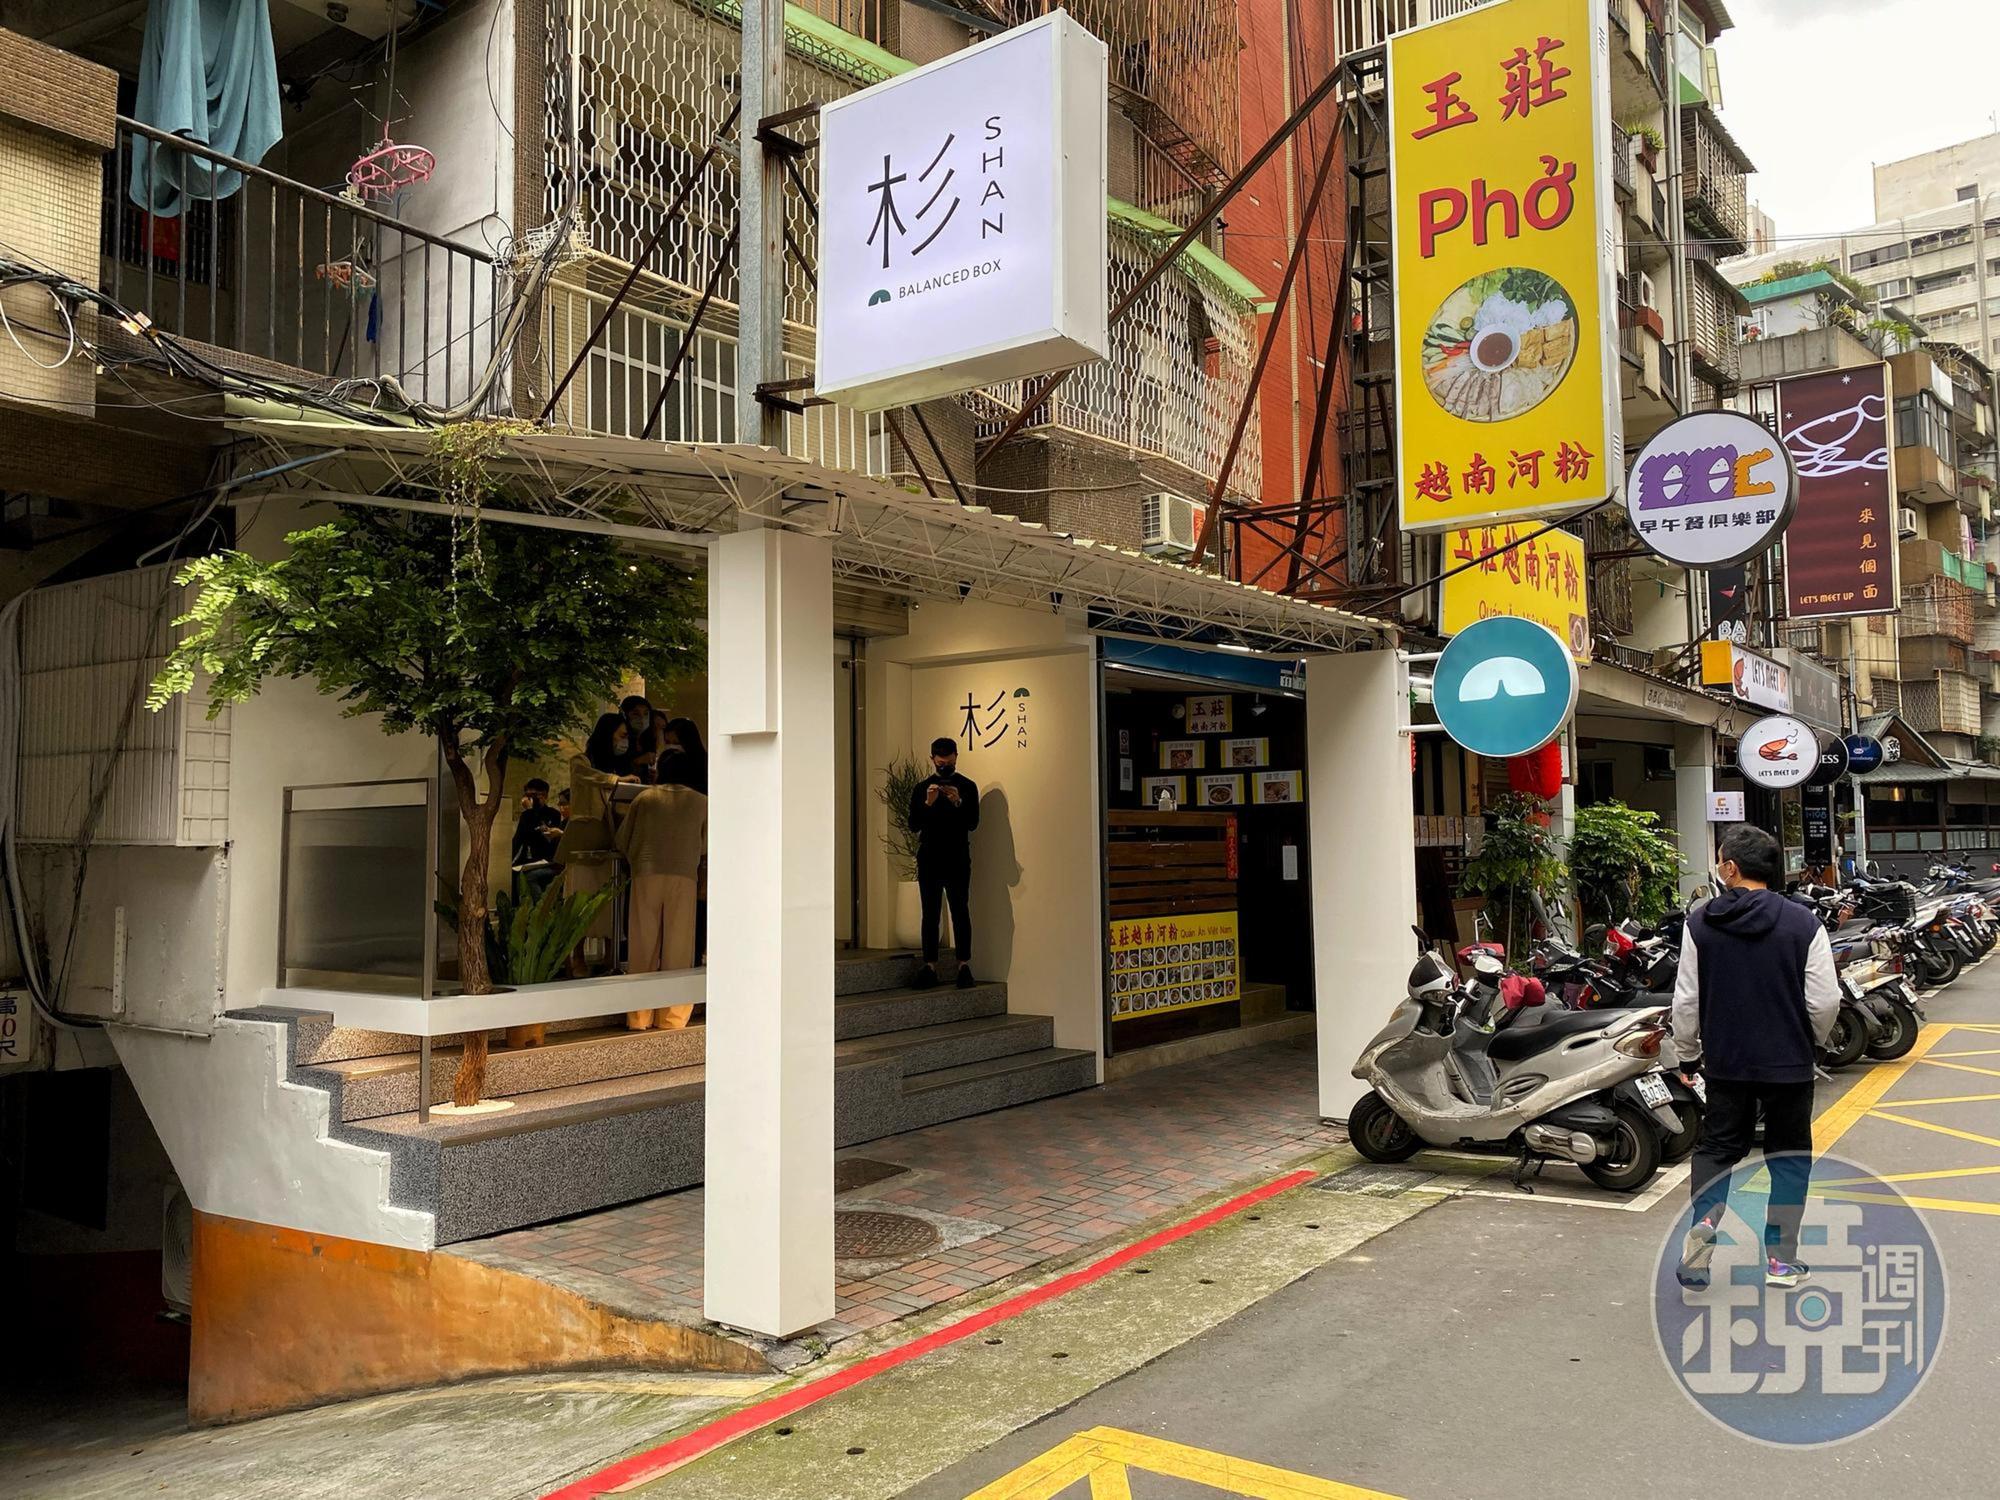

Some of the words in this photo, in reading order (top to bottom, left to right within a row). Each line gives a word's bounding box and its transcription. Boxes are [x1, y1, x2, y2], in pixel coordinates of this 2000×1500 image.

[1411, 36, 1572, 140] 玉莊
[866, 133, 961, 269] 杉
[981, 115, 1005, 240] SHAN
[1419, 155, 1577, 259] Phở
[898, 267, 969, 300] BALANCED
[973, 258, 1003, 279] BOX
[1414, 441, 1595, 503] 越南河粉
[1638, 509, 1776, 534] 早午餐俱樂部
[1858, 506, 1879, 600] 來見個面
[1800, 596, 1818, 605] LET'S
[1820, 593, 1841, 603] MEET
[1843, 592, 1854, 601] UP
[960, 690, 1009, 751] 杉
[1017, 702, 1027, 748] SHAN
[1192, 700, 1225, 717] 玉莊
[1773, 769, 1790, 777] MEET
